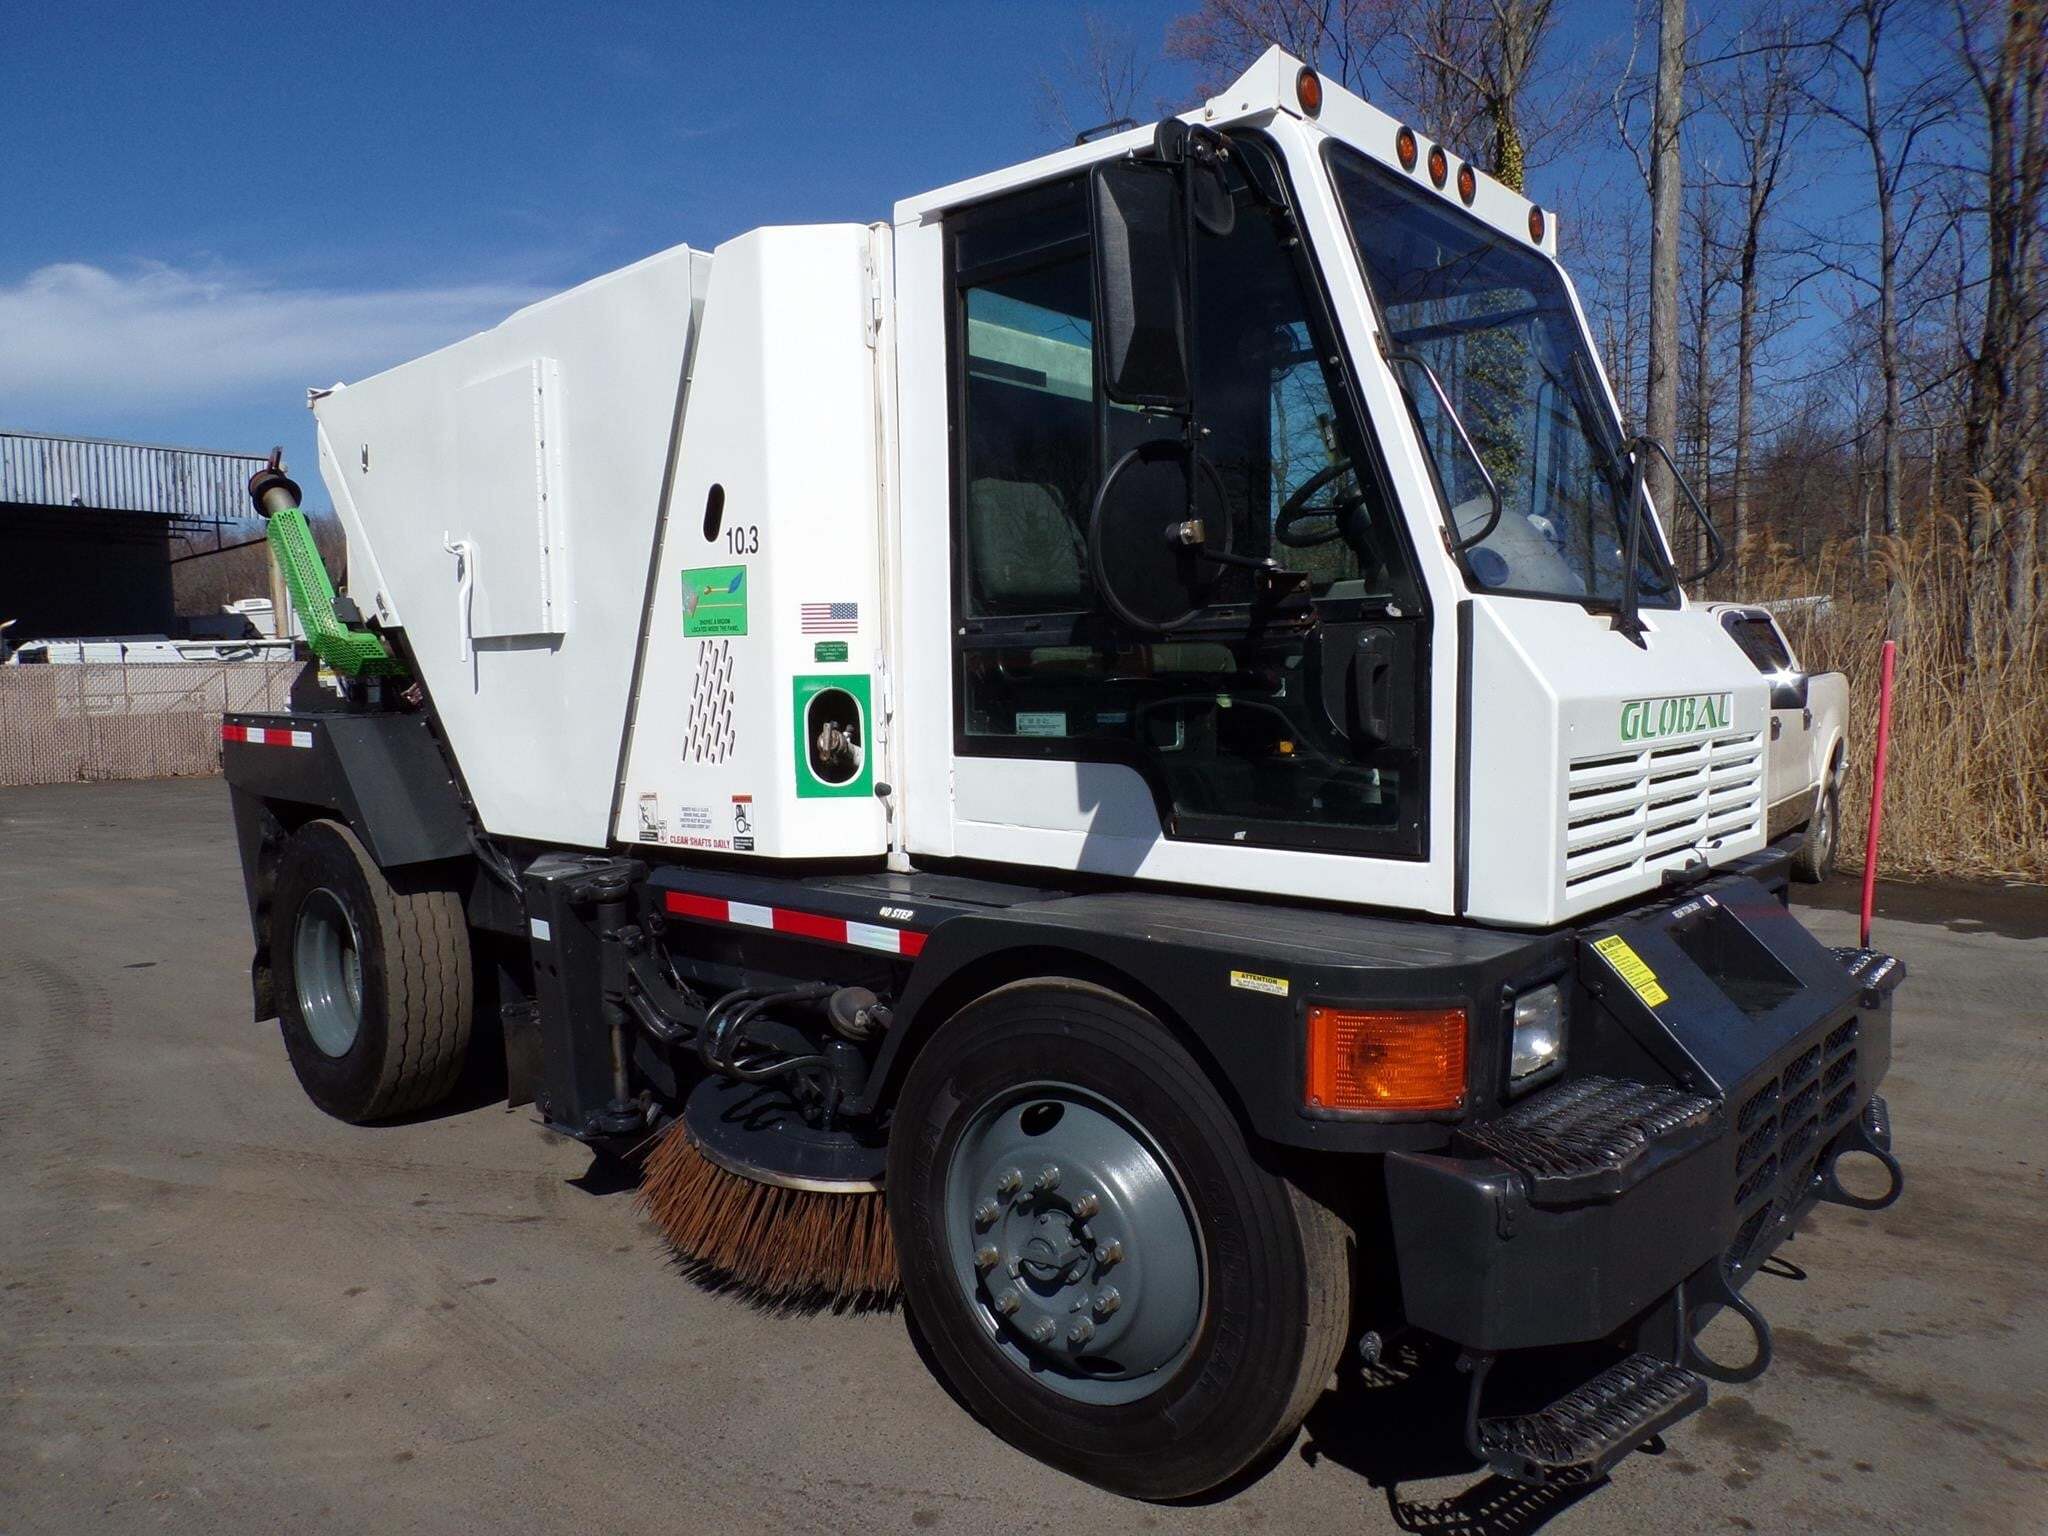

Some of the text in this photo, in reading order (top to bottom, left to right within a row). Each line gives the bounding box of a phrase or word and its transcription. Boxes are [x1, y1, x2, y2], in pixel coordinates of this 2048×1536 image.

[726, 525, 759, 555] 10.3
[1620, 694, 1731, 742] GLOBAL
[669, 835, 689, 846] CLEAN
[690, 837, 712, 848] SHAFTS
[714, 839, 731, 849] DAILY
[880, 906, 913, 921] NO STEP
[1241, 973, 1278, 985] ATTENTION
